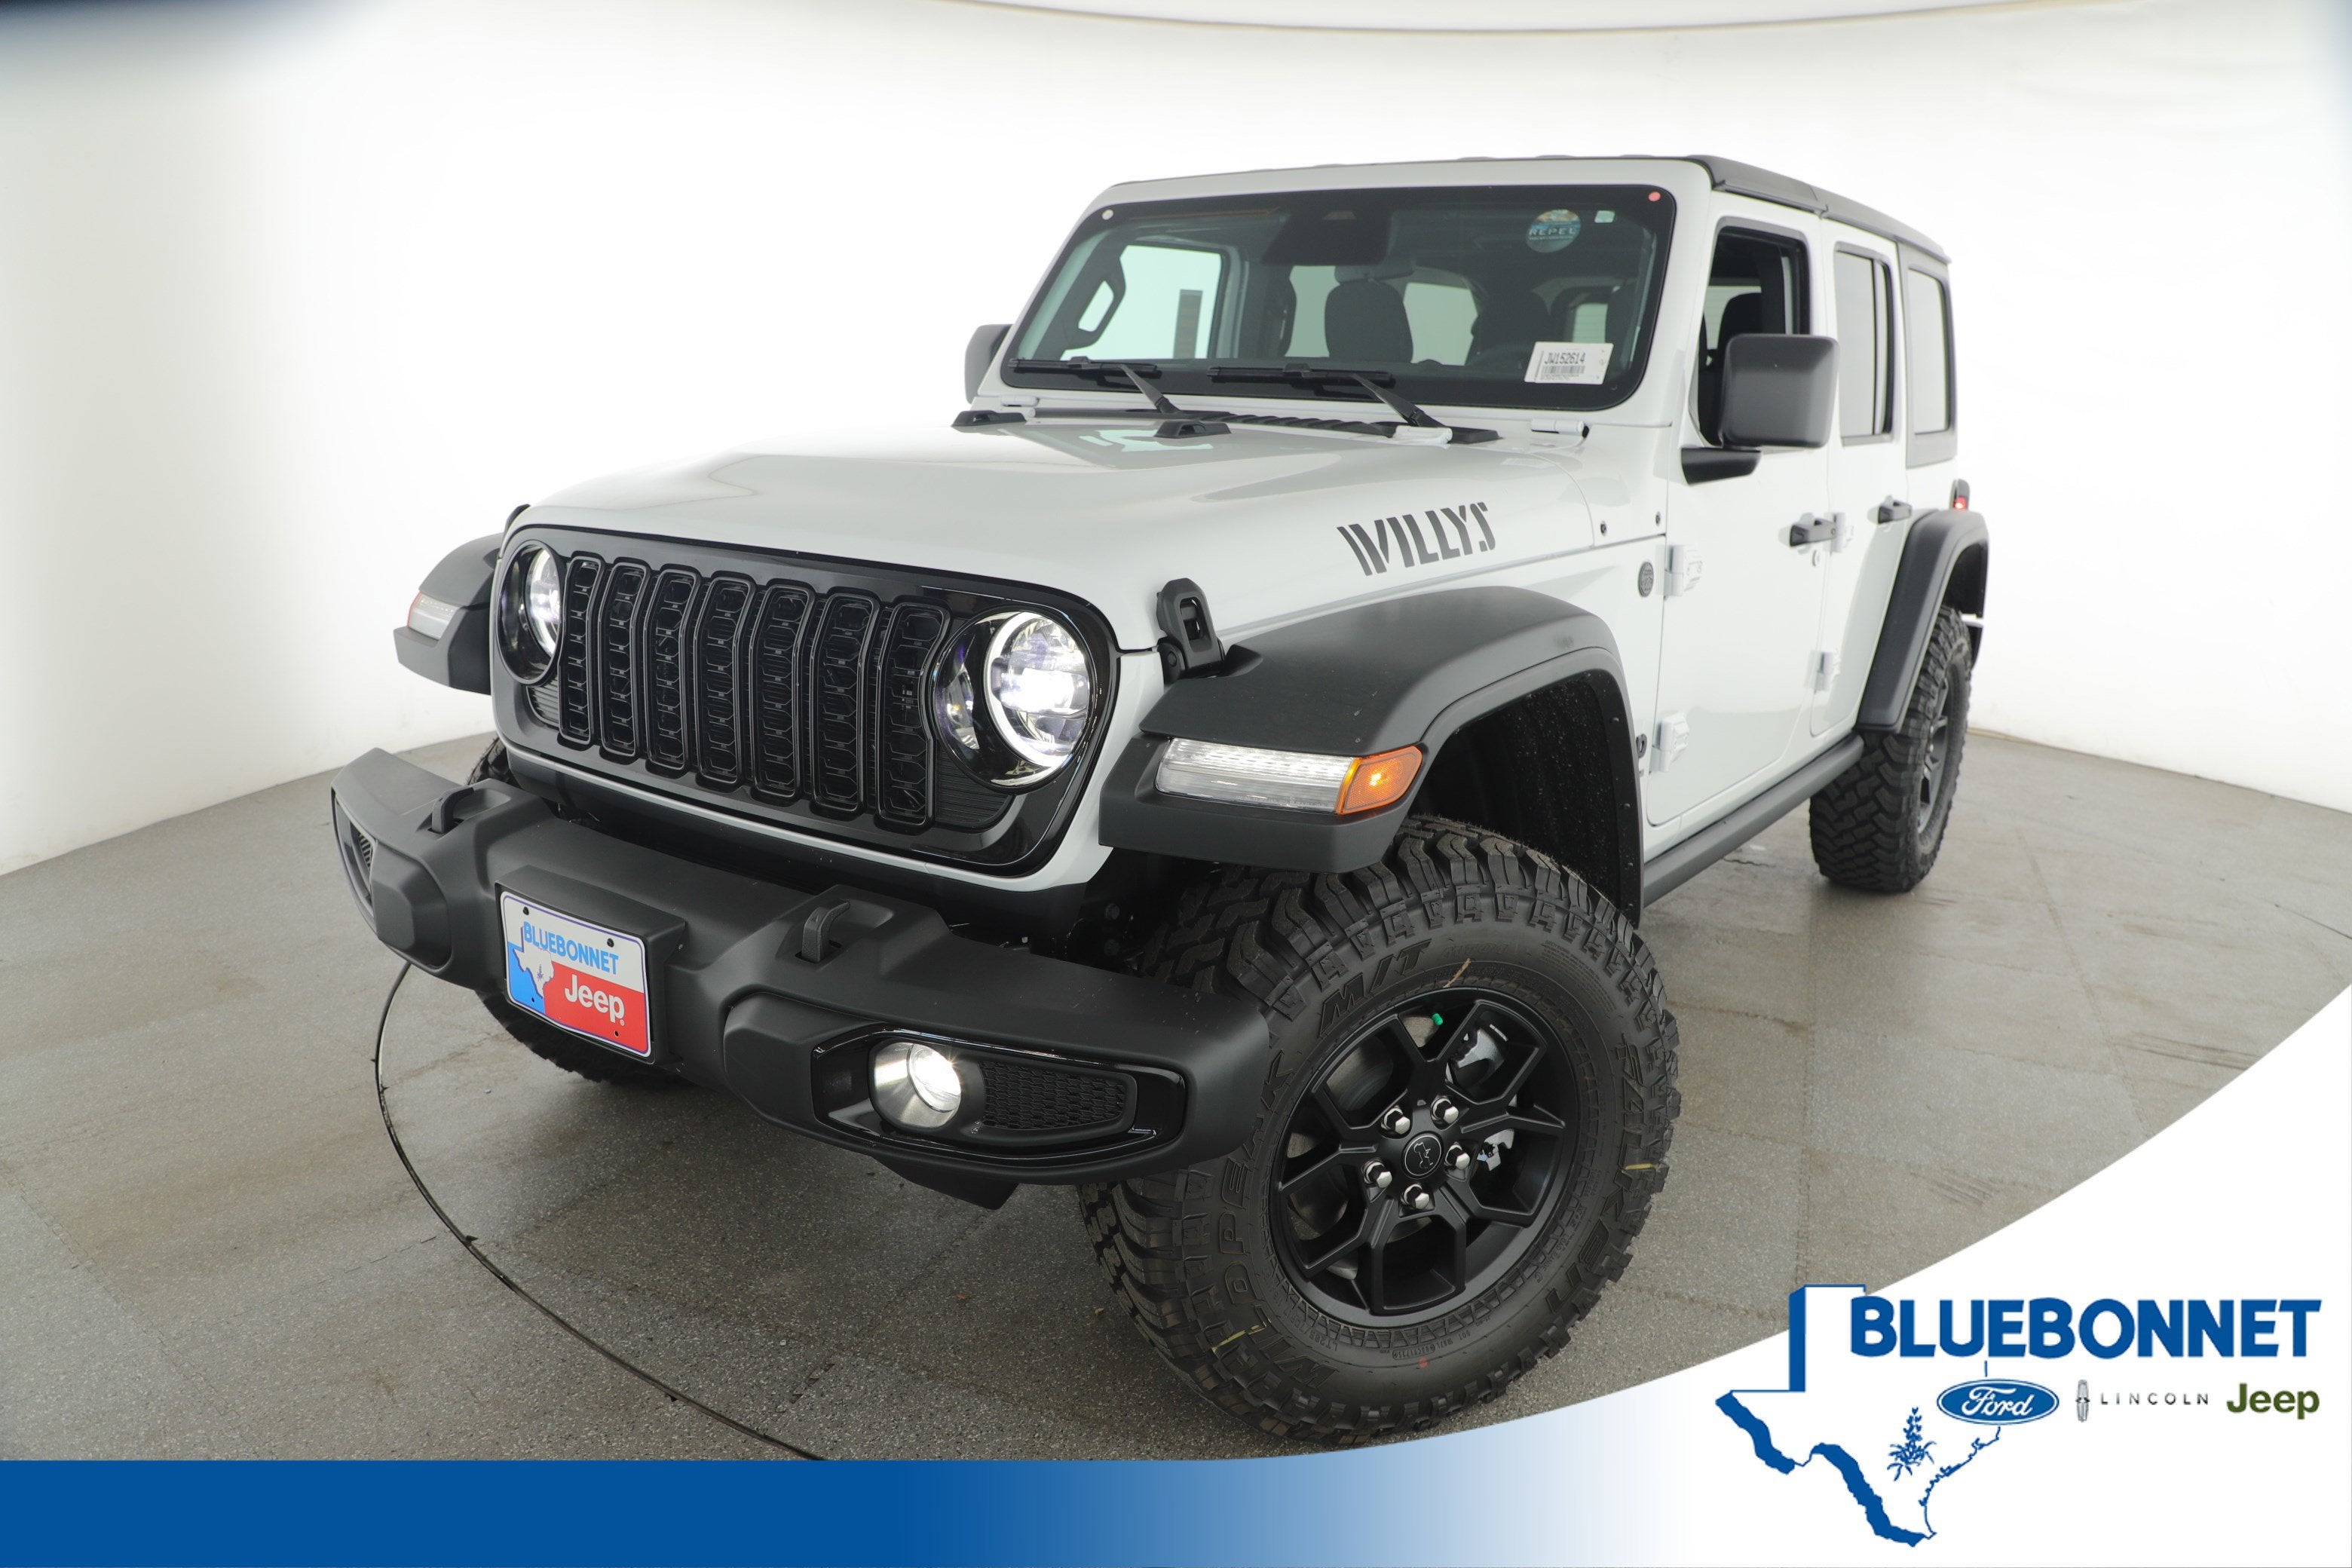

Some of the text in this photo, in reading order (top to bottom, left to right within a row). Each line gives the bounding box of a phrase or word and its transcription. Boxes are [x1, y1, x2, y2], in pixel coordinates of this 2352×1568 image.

[1529, 228, 1576, 236] REPEL
[1545, 352, 1585, 365] JW152614
[1336, 501, 1496, 576] WILLYS
[523, 920, 619, 975] BLUEBONNET
[564, 974, 625, 1024] Jeep
[1545, 1033, 1644, 1315] FALKEN
